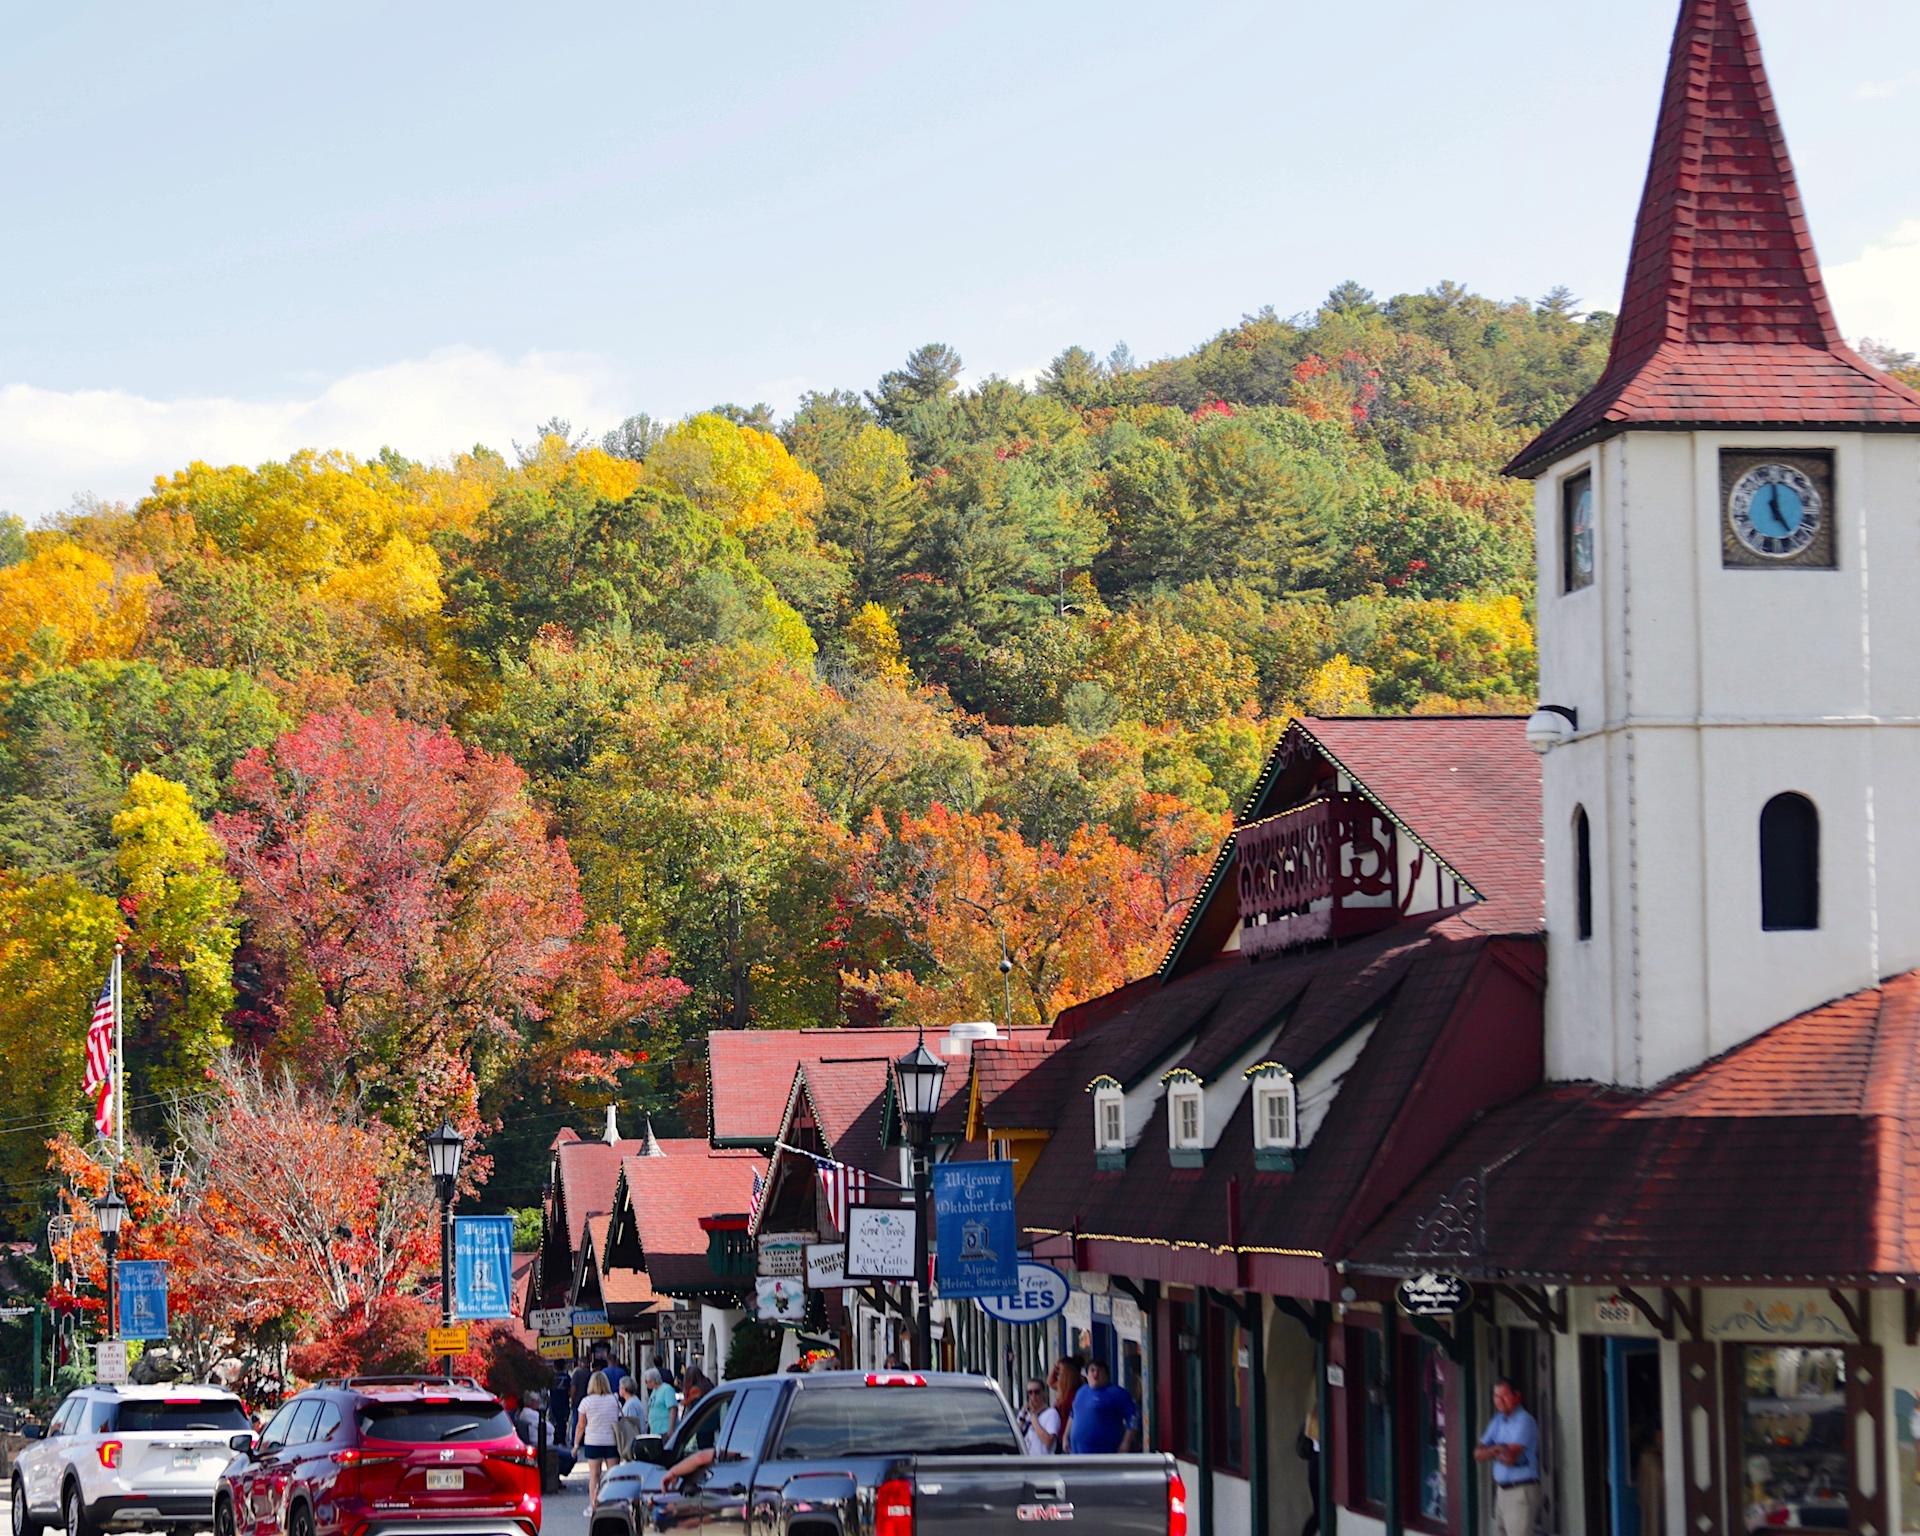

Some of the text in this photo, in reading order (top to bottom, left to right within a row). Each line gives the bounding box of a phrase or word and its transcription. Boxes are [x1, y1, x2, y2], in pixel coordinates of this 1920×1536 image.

[944, 1172, 1002, 1189] Welcome
[964, 1188, 984, 1200] To
[936, 1200, 1013, 1214] Oktoberfest
[463, 1223, 505, 1237] Welcome
[456, 1244, 510, 1255] Oktoberfest
[856, 1254, 908, 1265] Fine Gifts
[860, 1265, 902, 1274] & More
[964, 1263, 997, 1277] Alpine
[942, 1277, 1018, 1290] Helen, Georgia
[997, 1290, 1055, 1310] TEES
[541, 1338, 571, 1348] JEWELS
[1016, 1503, 1074, 1521] GMC
